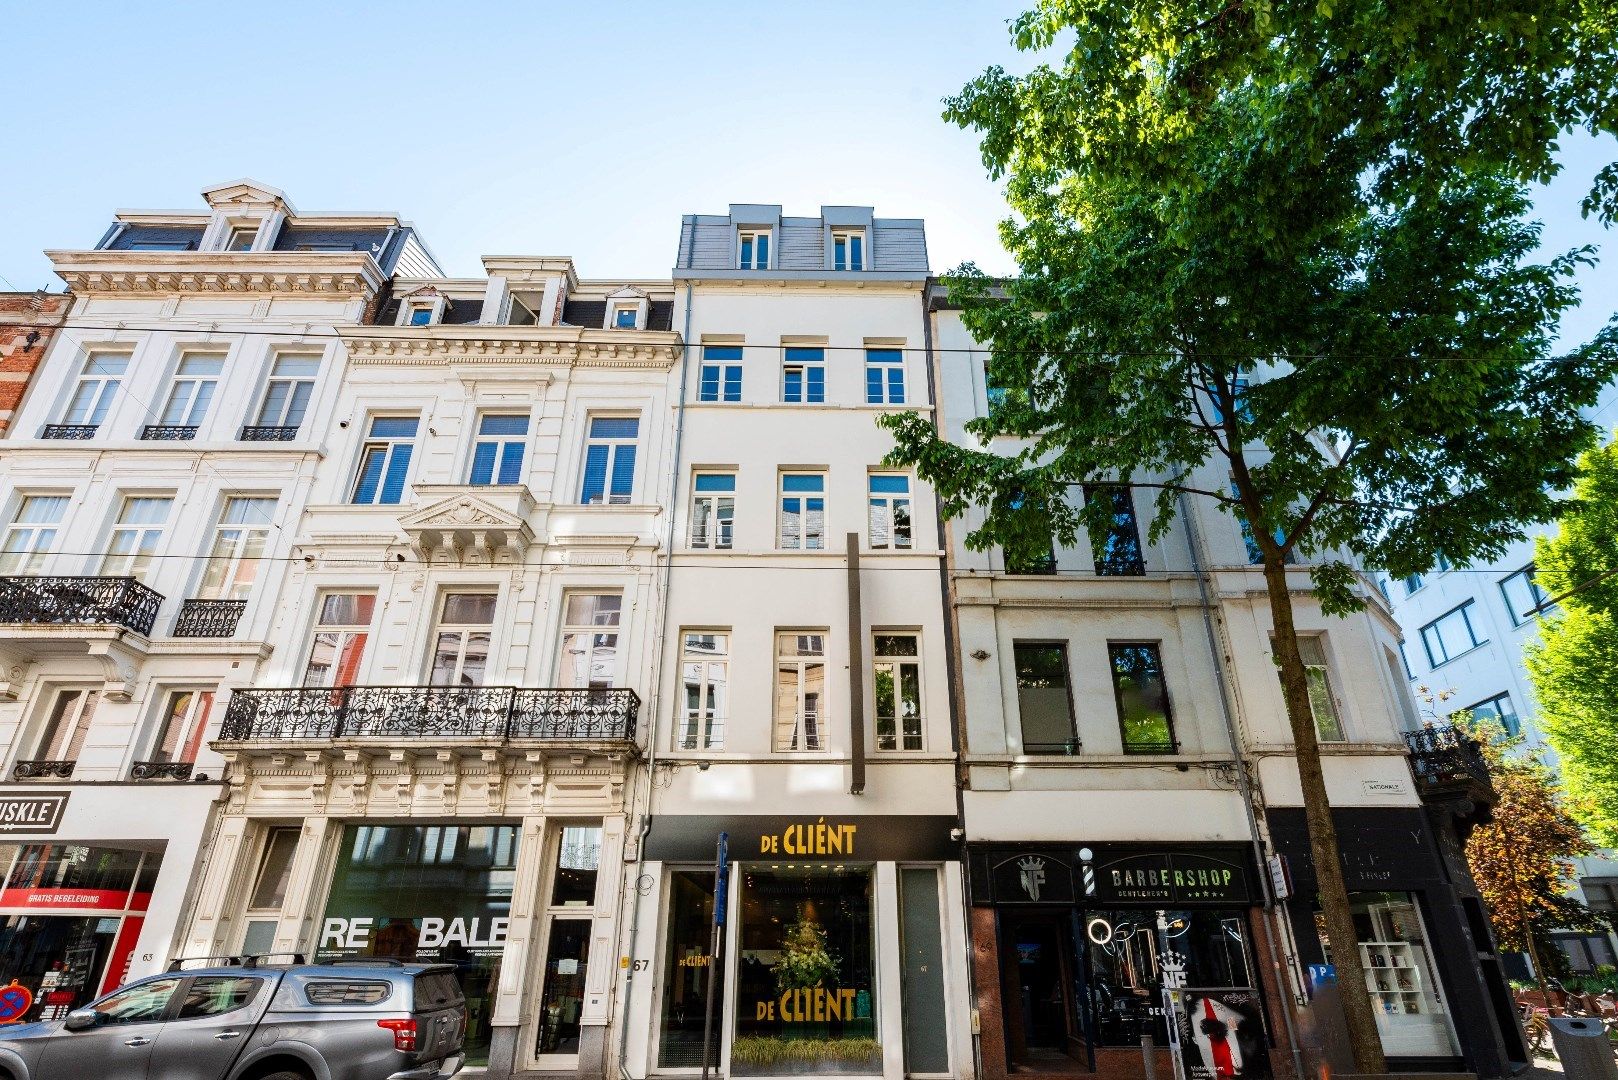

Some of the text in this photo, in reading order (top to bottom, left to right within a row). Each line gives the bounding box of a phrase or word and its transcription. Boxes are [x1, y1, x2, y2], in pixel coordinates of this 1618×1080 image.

[760, 816, 857, 854] DE CLIÉNT
[1111, 869, 1231, 886] BARBERSHOP
[28, 894, 99, 903] GRATIS BEGELEIDING
[319, 917, 374, 948] RE
[142, 954, 154, 962] 63
[633, 959, 649, 971] 67
[756, 979, 856, 1022] DE CLIÉNT
